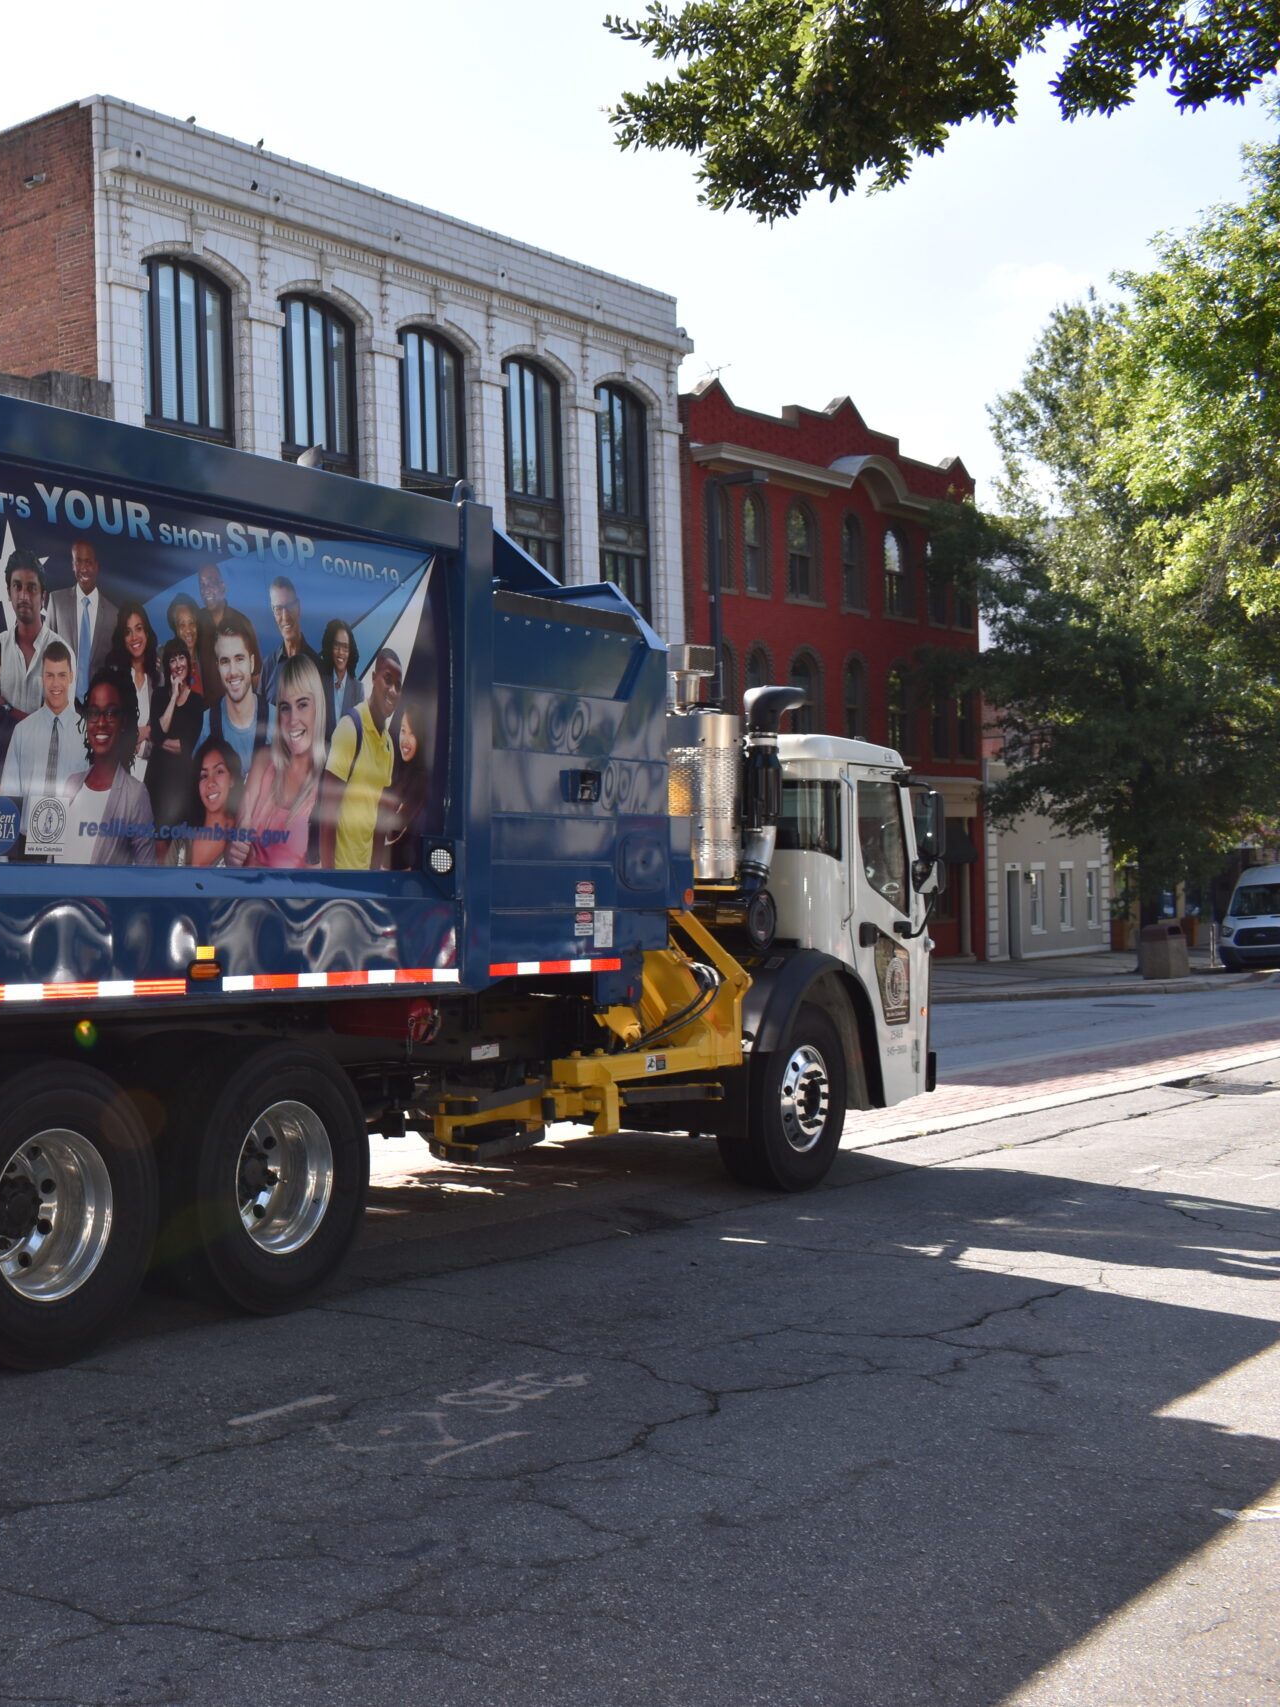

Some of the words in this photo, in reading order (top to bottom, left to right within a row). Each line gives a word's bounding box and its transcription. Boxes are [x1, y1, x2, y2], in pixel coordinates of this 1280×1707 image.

[34, 482, 154, 542] YOUR
[158, 523, 223, 554] SHOT!
[226, 521, 316, 569] STOP
[78, 818, 291, 848] resilient.columbiasc.gov
